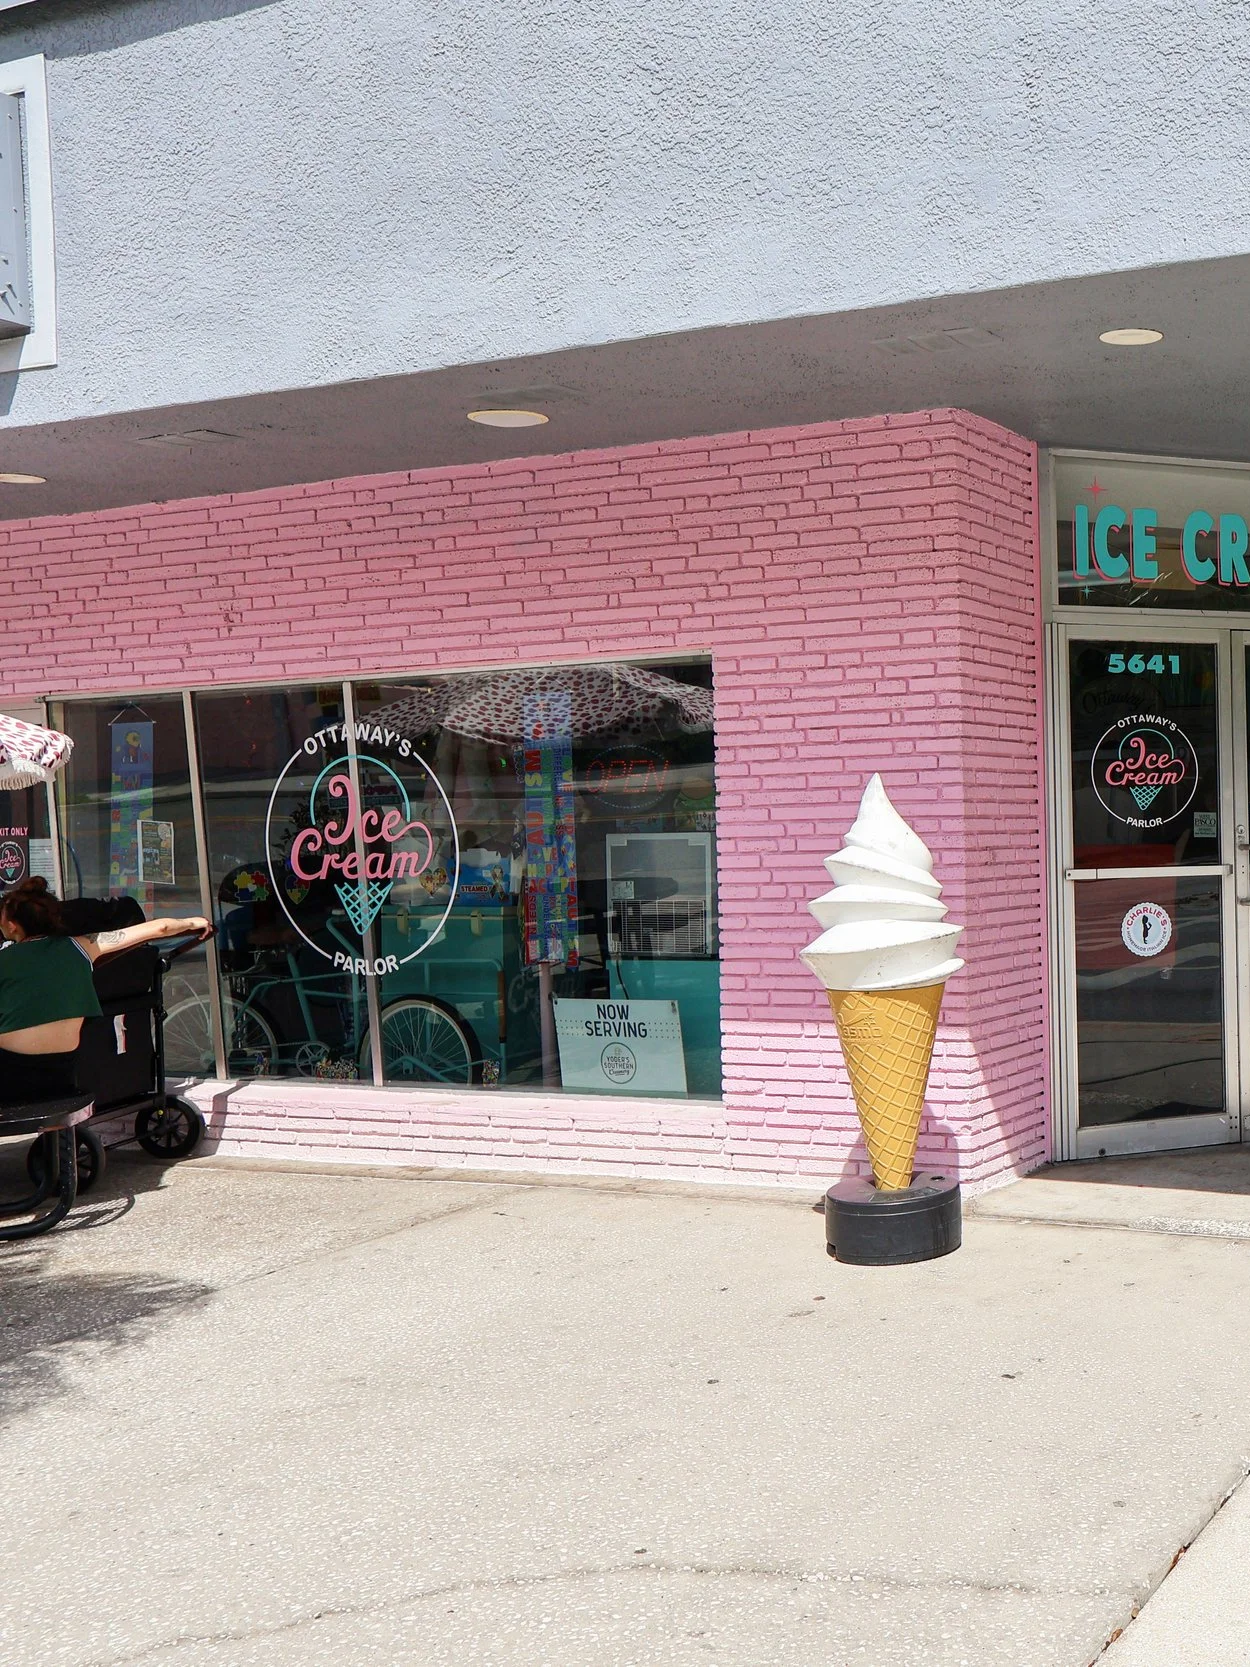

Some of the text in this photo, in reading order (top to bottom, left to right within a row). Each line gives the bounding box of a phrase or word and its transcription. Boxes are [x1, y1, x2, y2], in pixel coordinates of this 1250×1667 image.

[1072, 504, 1160, 583] ICE
[1108, 653, 1181, 675] 5641
[1117, 714, 1177, 732] OTTAWAY'S
[303, 723, 412, 757] OTTAWAY'S
[1127, 737, 1172, 770] Ice
[585, 760, 670, 793] OPEN
[1105, 758, 1185, 786] Cream
[323, 774, 406, 845] Ice
[0, 826, 29, 836] XIT ONLY
[1126, 817, 1164, 828] PARLOR
[291, 822, 433, 880] Cream
[460, 885, 489, 893] STEAMED
[1127, 907, 1168, 927] CHARLIE'S
[333, 954, 401, 976] PARLOR
[597, 1004, 629, 1020] NOW
[585, 1020, 648, 1038] SERVING
[604, 1062, 634, 1070] SOUTHERN
